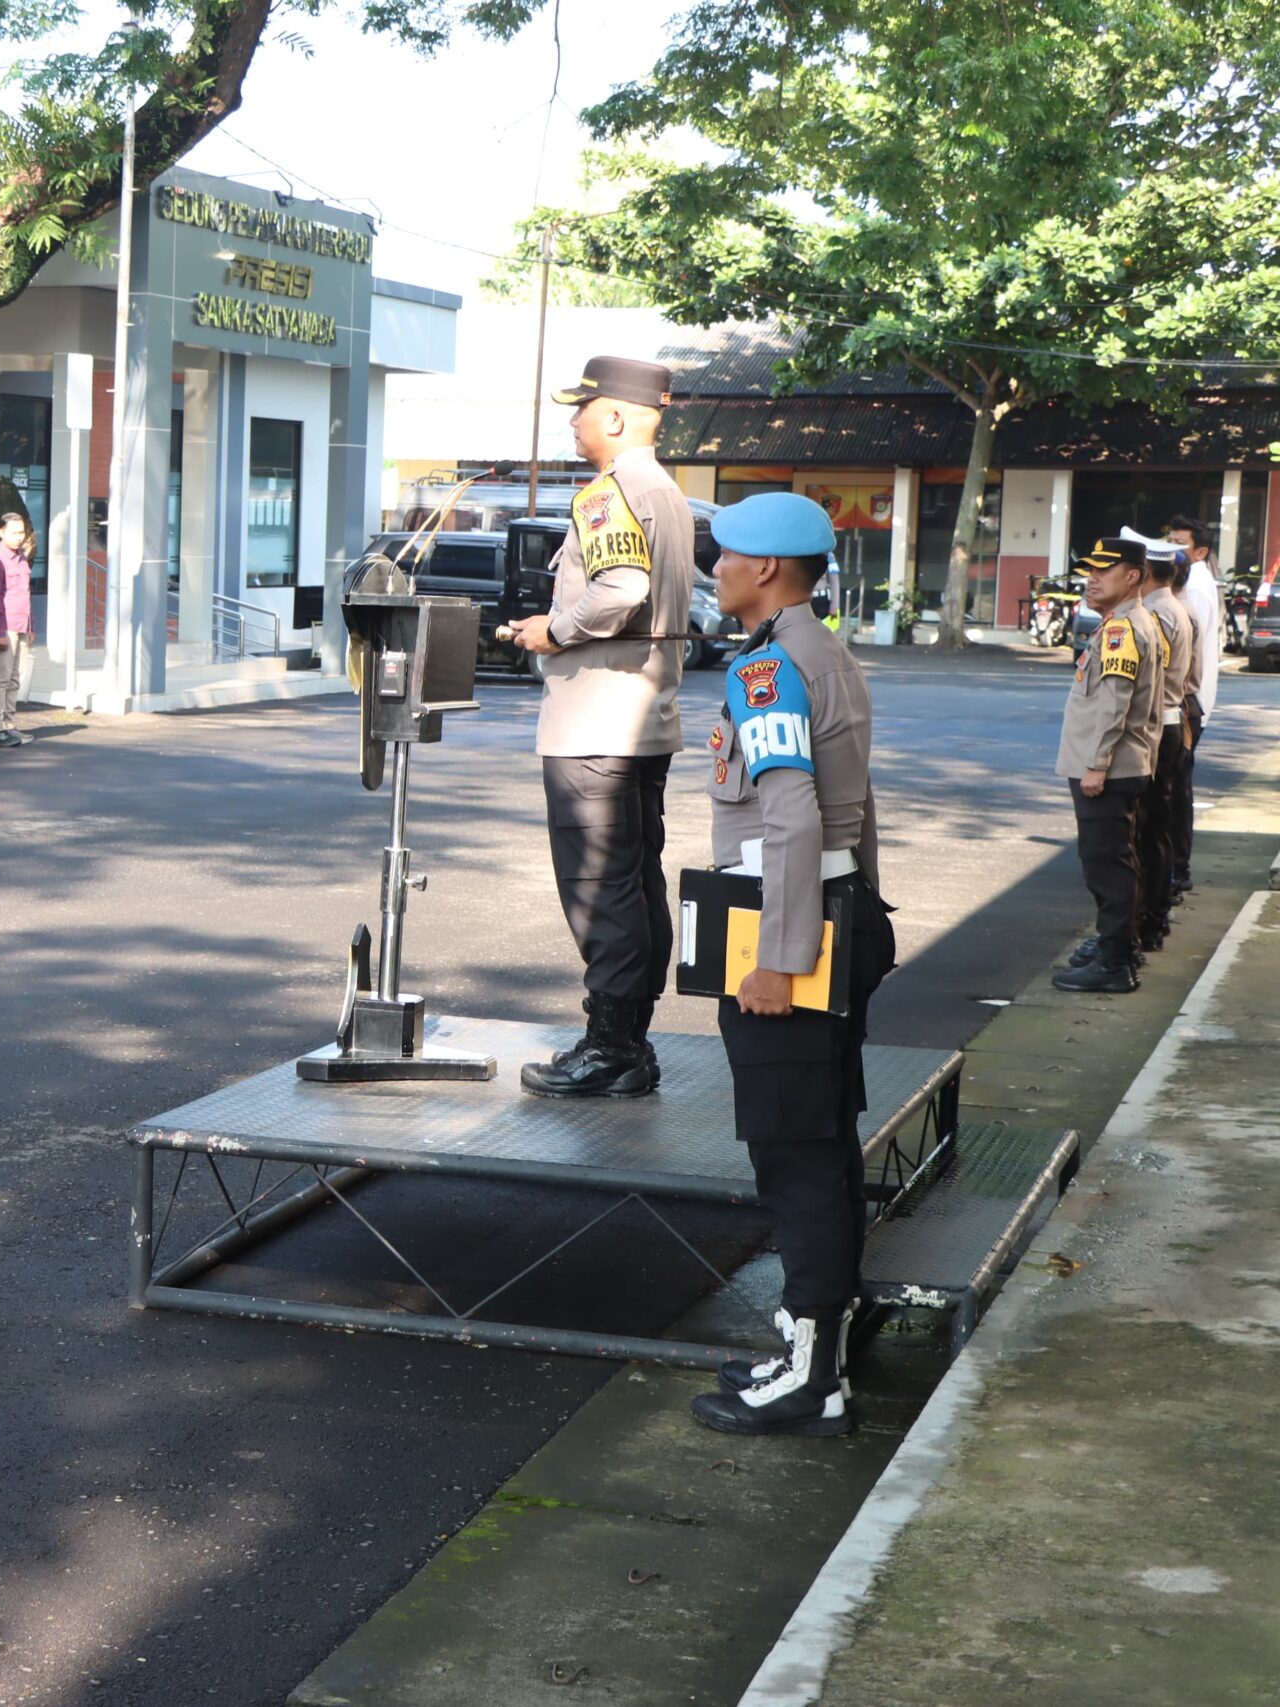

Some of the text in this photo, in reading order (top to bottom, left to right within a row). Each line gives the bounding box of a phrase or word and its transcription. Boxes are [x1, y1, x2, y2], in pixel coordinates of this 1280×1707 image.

[157, 185, 227, 232] GEDUNG
[312, 219, 371, 264] TERPADU
[586, 531, 646, 571] OPS RESTA
[1105, 657, 1120, 672] OPS
